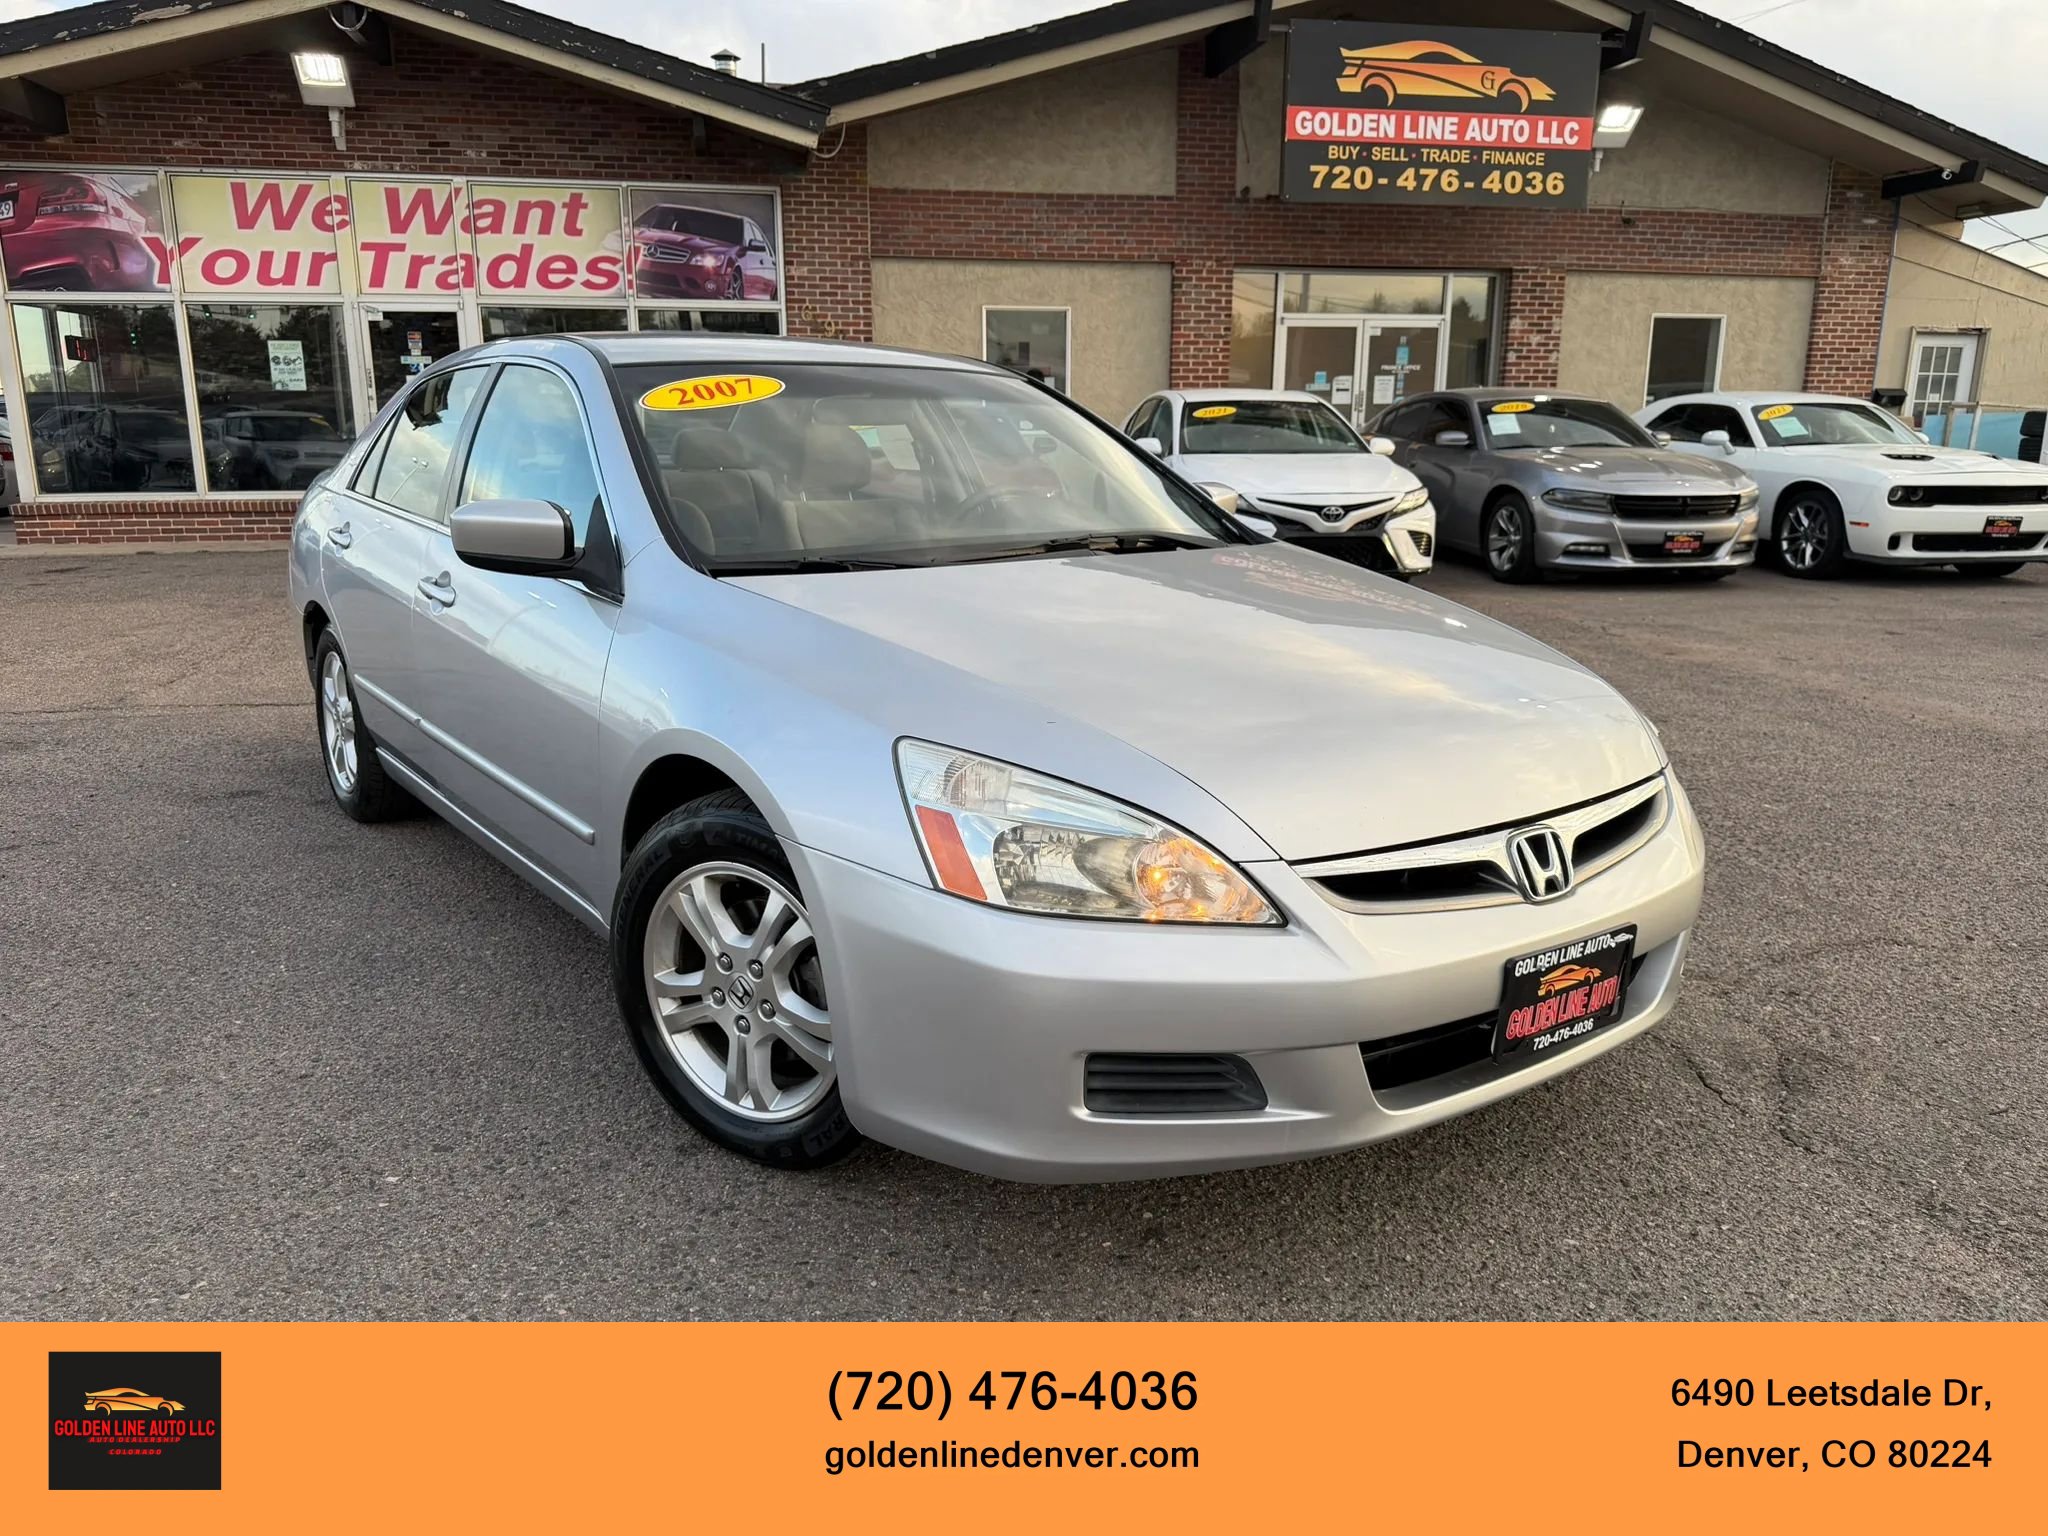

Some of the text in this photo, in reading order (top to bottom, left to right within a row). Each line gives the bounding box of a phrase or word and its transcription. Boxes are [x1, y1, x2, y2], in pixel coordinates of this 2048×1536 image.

[1295, 111, 1580, 145] GOLDEN LINE AUTO LLC
[1328, 145, 1545, 166] BUY SELL TRADE FINANCE
[229, 182, 589, 237] We Want
[141, 237, 641, 291] Your Trades!
[669, 378, 753, 405] 2007
[1514, 933, 1612, 977] GOLDEN LINE AUTO
[1505, 975, 1618, 1040] GOLDEN LINE AUTO
[1533, 1018, 1594, 1051] 720-476-4036
